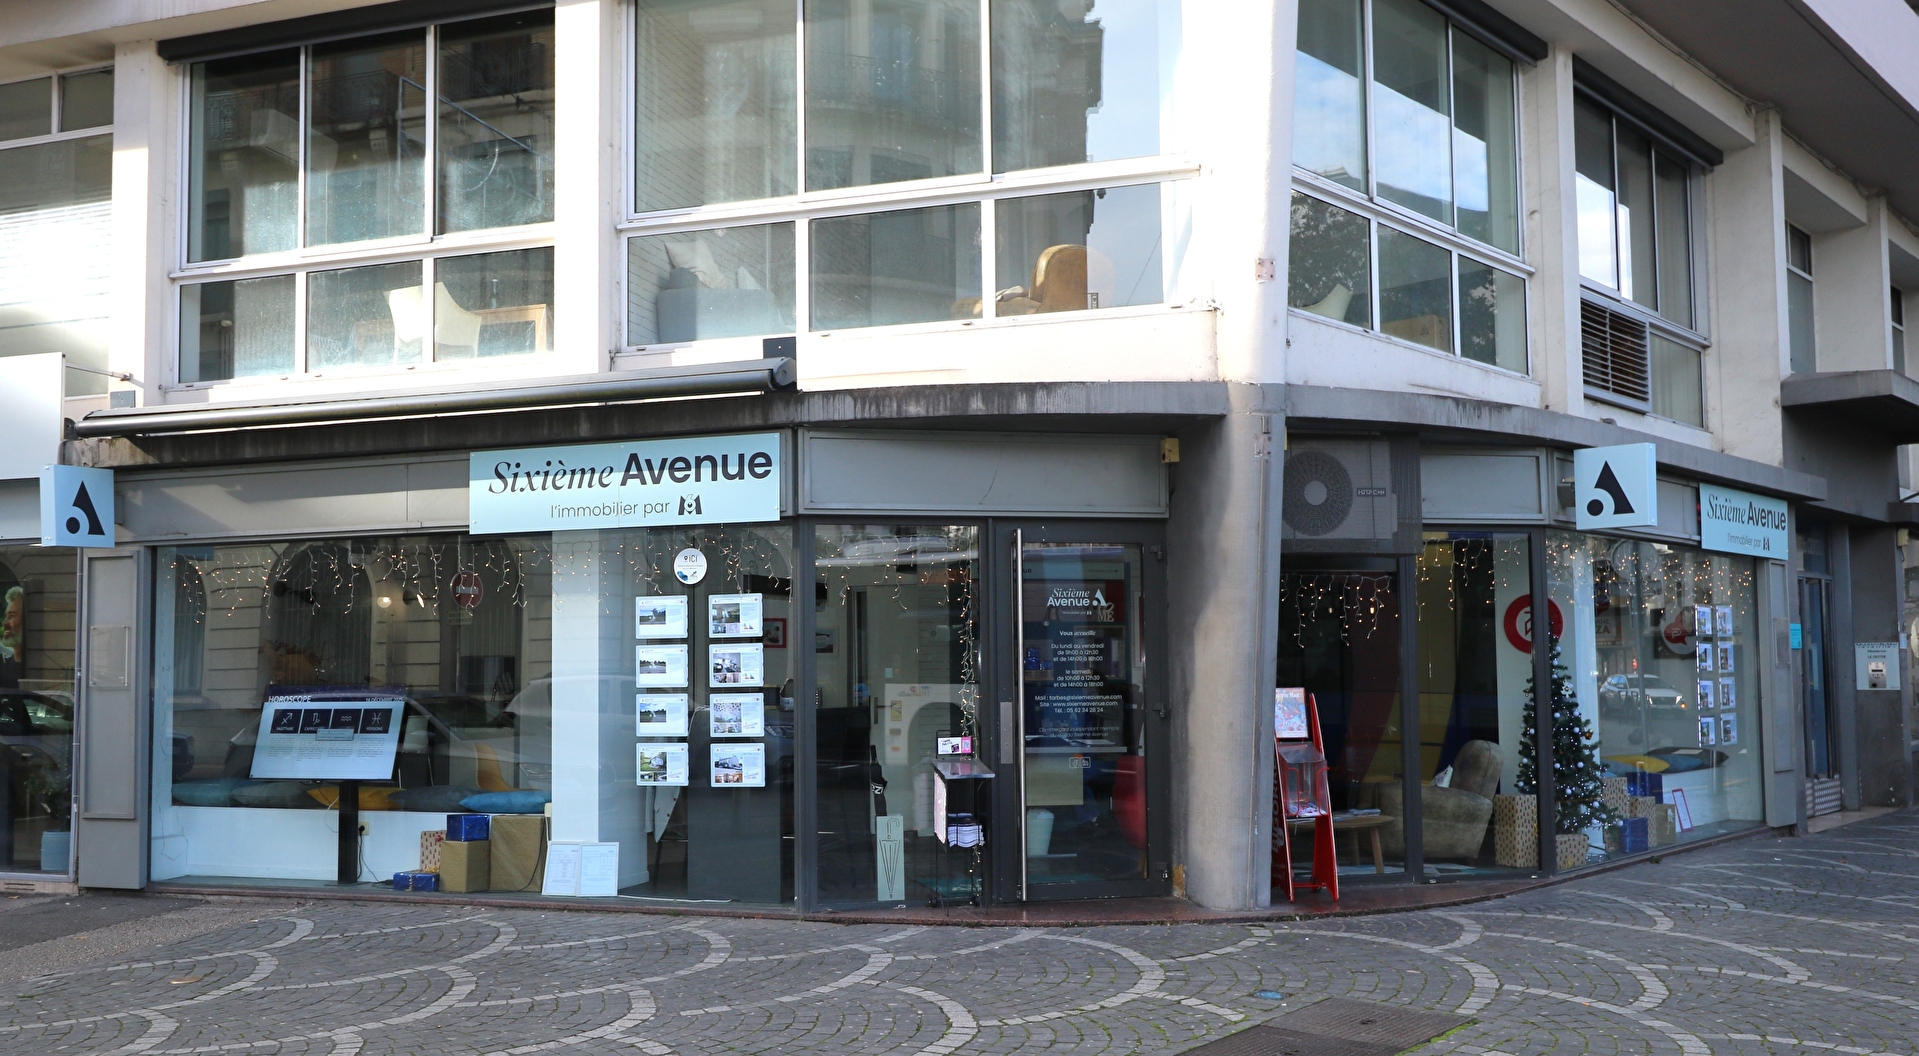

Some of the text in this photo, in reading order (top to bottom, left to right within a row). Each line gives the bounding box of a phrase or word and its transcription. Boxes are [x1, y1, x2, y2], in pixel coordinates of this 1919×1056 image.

[488, 451, 773, 495] Sixième Avenue
[550, 502, 638, 519] l'immobilier
[643, 501, 670, 518] par
[1707, 494, 1787, 531] Sixième Avenue
[1727, 532, 1753, 547] l'immobilier
[1753, 537, 1762, 548] par
[1052, 588, 1090, 598] Sixième
[1047, 597, 1090, 607] Avenue
